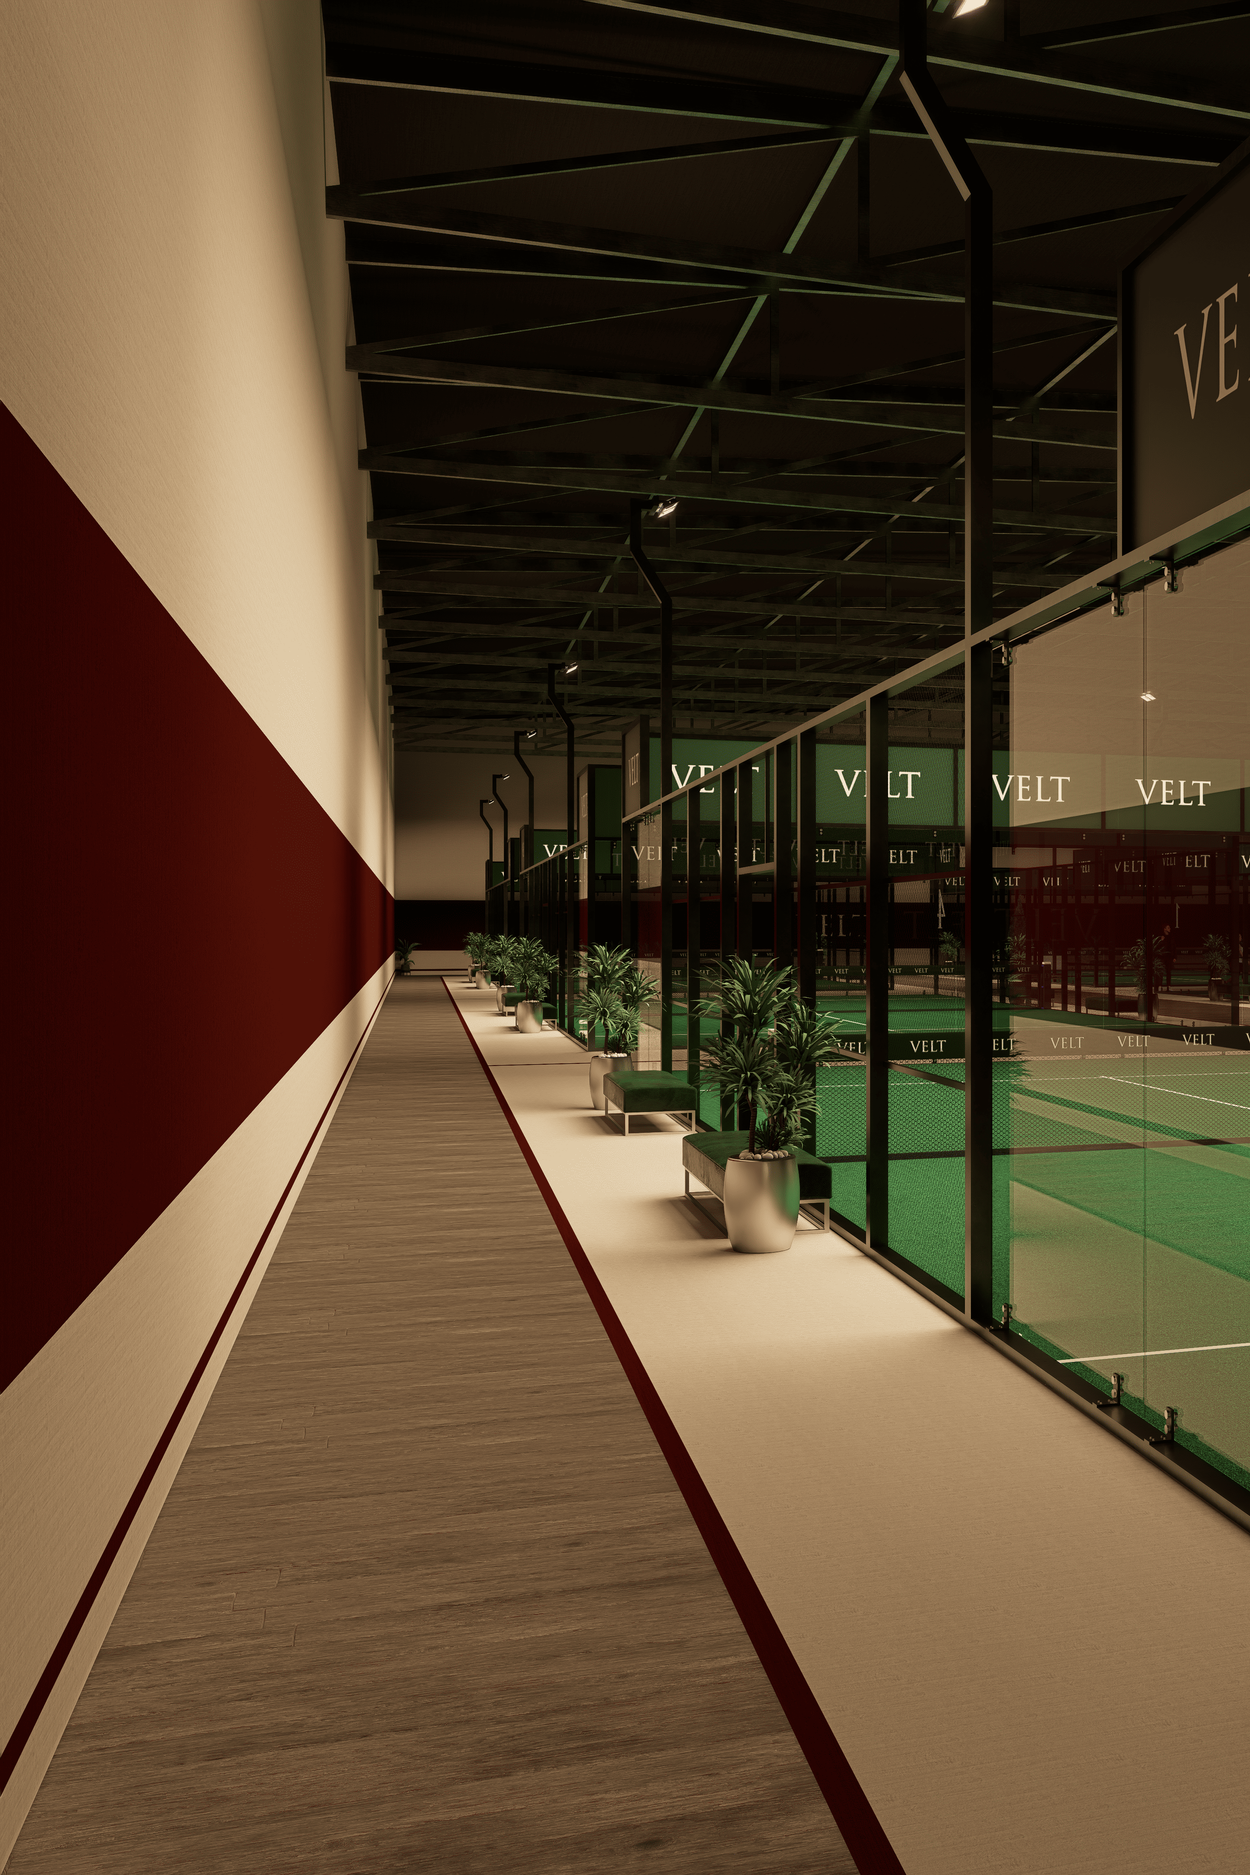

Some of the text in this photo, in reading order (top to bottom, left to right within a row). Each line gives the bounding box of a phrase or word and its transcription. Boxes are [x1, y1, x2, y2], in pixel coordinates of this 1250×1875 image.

[671, 763, 760, 794] VE
[834, 768, 921, 799] VLT
[991, 774, 1071, 803] VELT
[1135, 778, 1212, 807] VELT
[889, 849, 918, 865] ELT
[1185, 854, 1211, 869] ELT
[837, 1041, 867, 1055] VEL
[909, 1039, 947, 1054] VELT
[992, 1037, 1016, 1051] ELT
[1050, 1036, 1085, 1050] VELT
[1117, 1034, 1150, 1048] VELT
[1182, 1033, 1216, 1047] VELT
